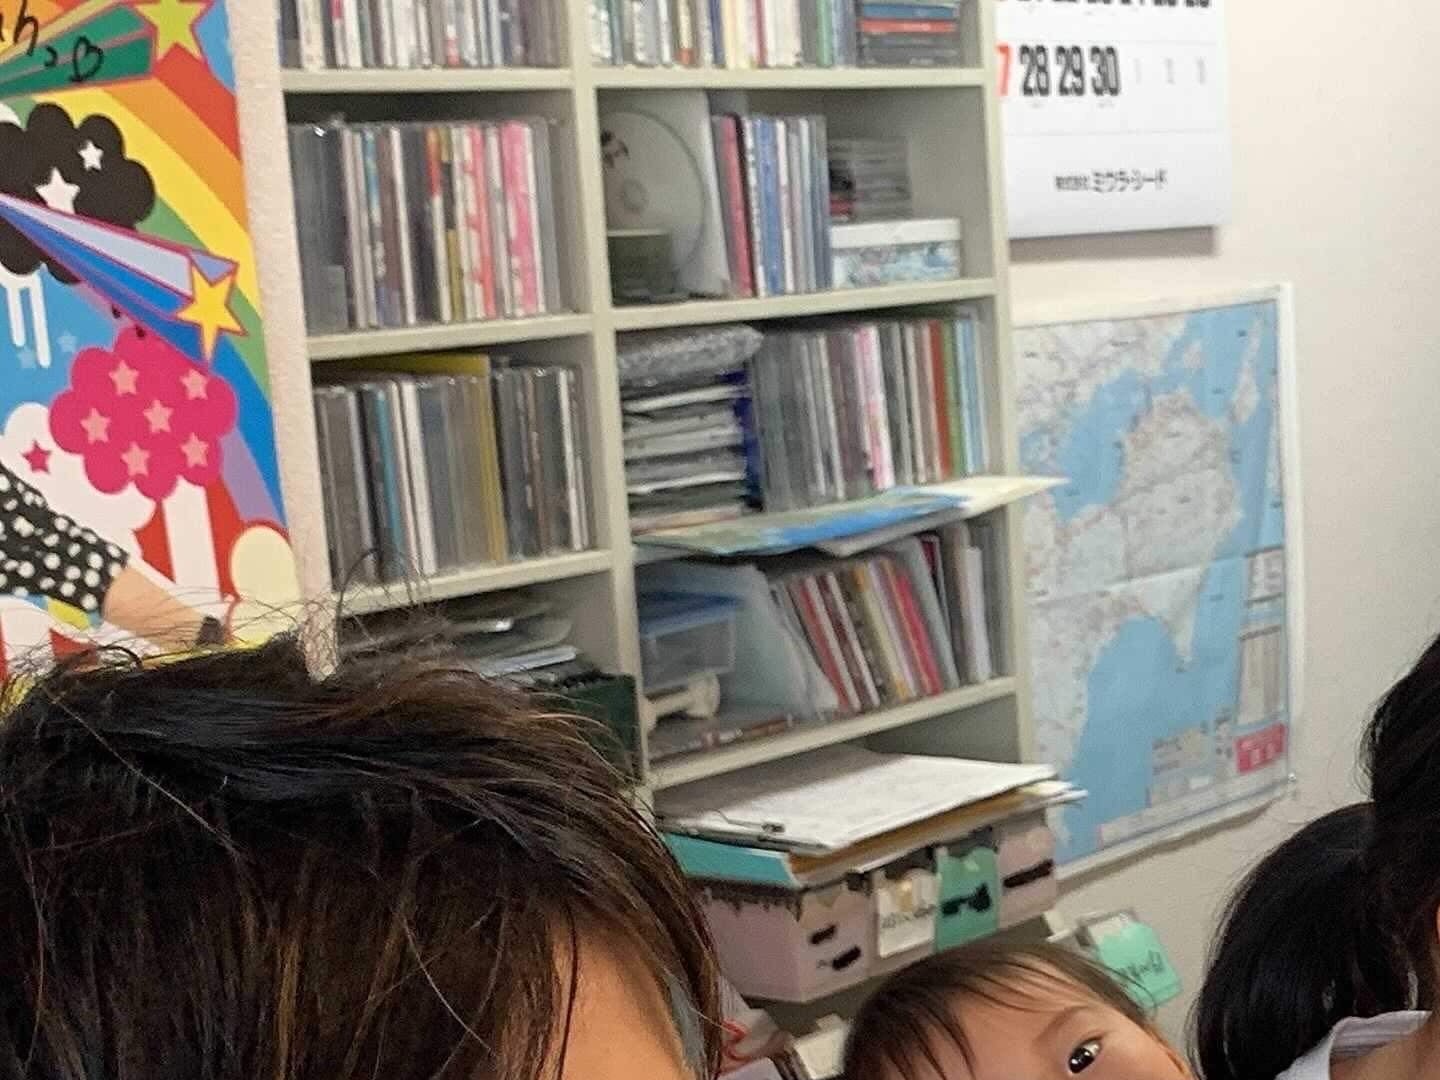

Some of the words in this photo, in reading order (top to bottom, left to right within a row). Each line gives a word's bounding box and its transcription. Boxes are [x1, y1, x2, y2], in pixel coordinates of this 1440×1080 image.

[1020, 45, 1051, 97] 28
[1056, 45, 1086, 97] 29
[1090, 46, 1122, 97] 30
